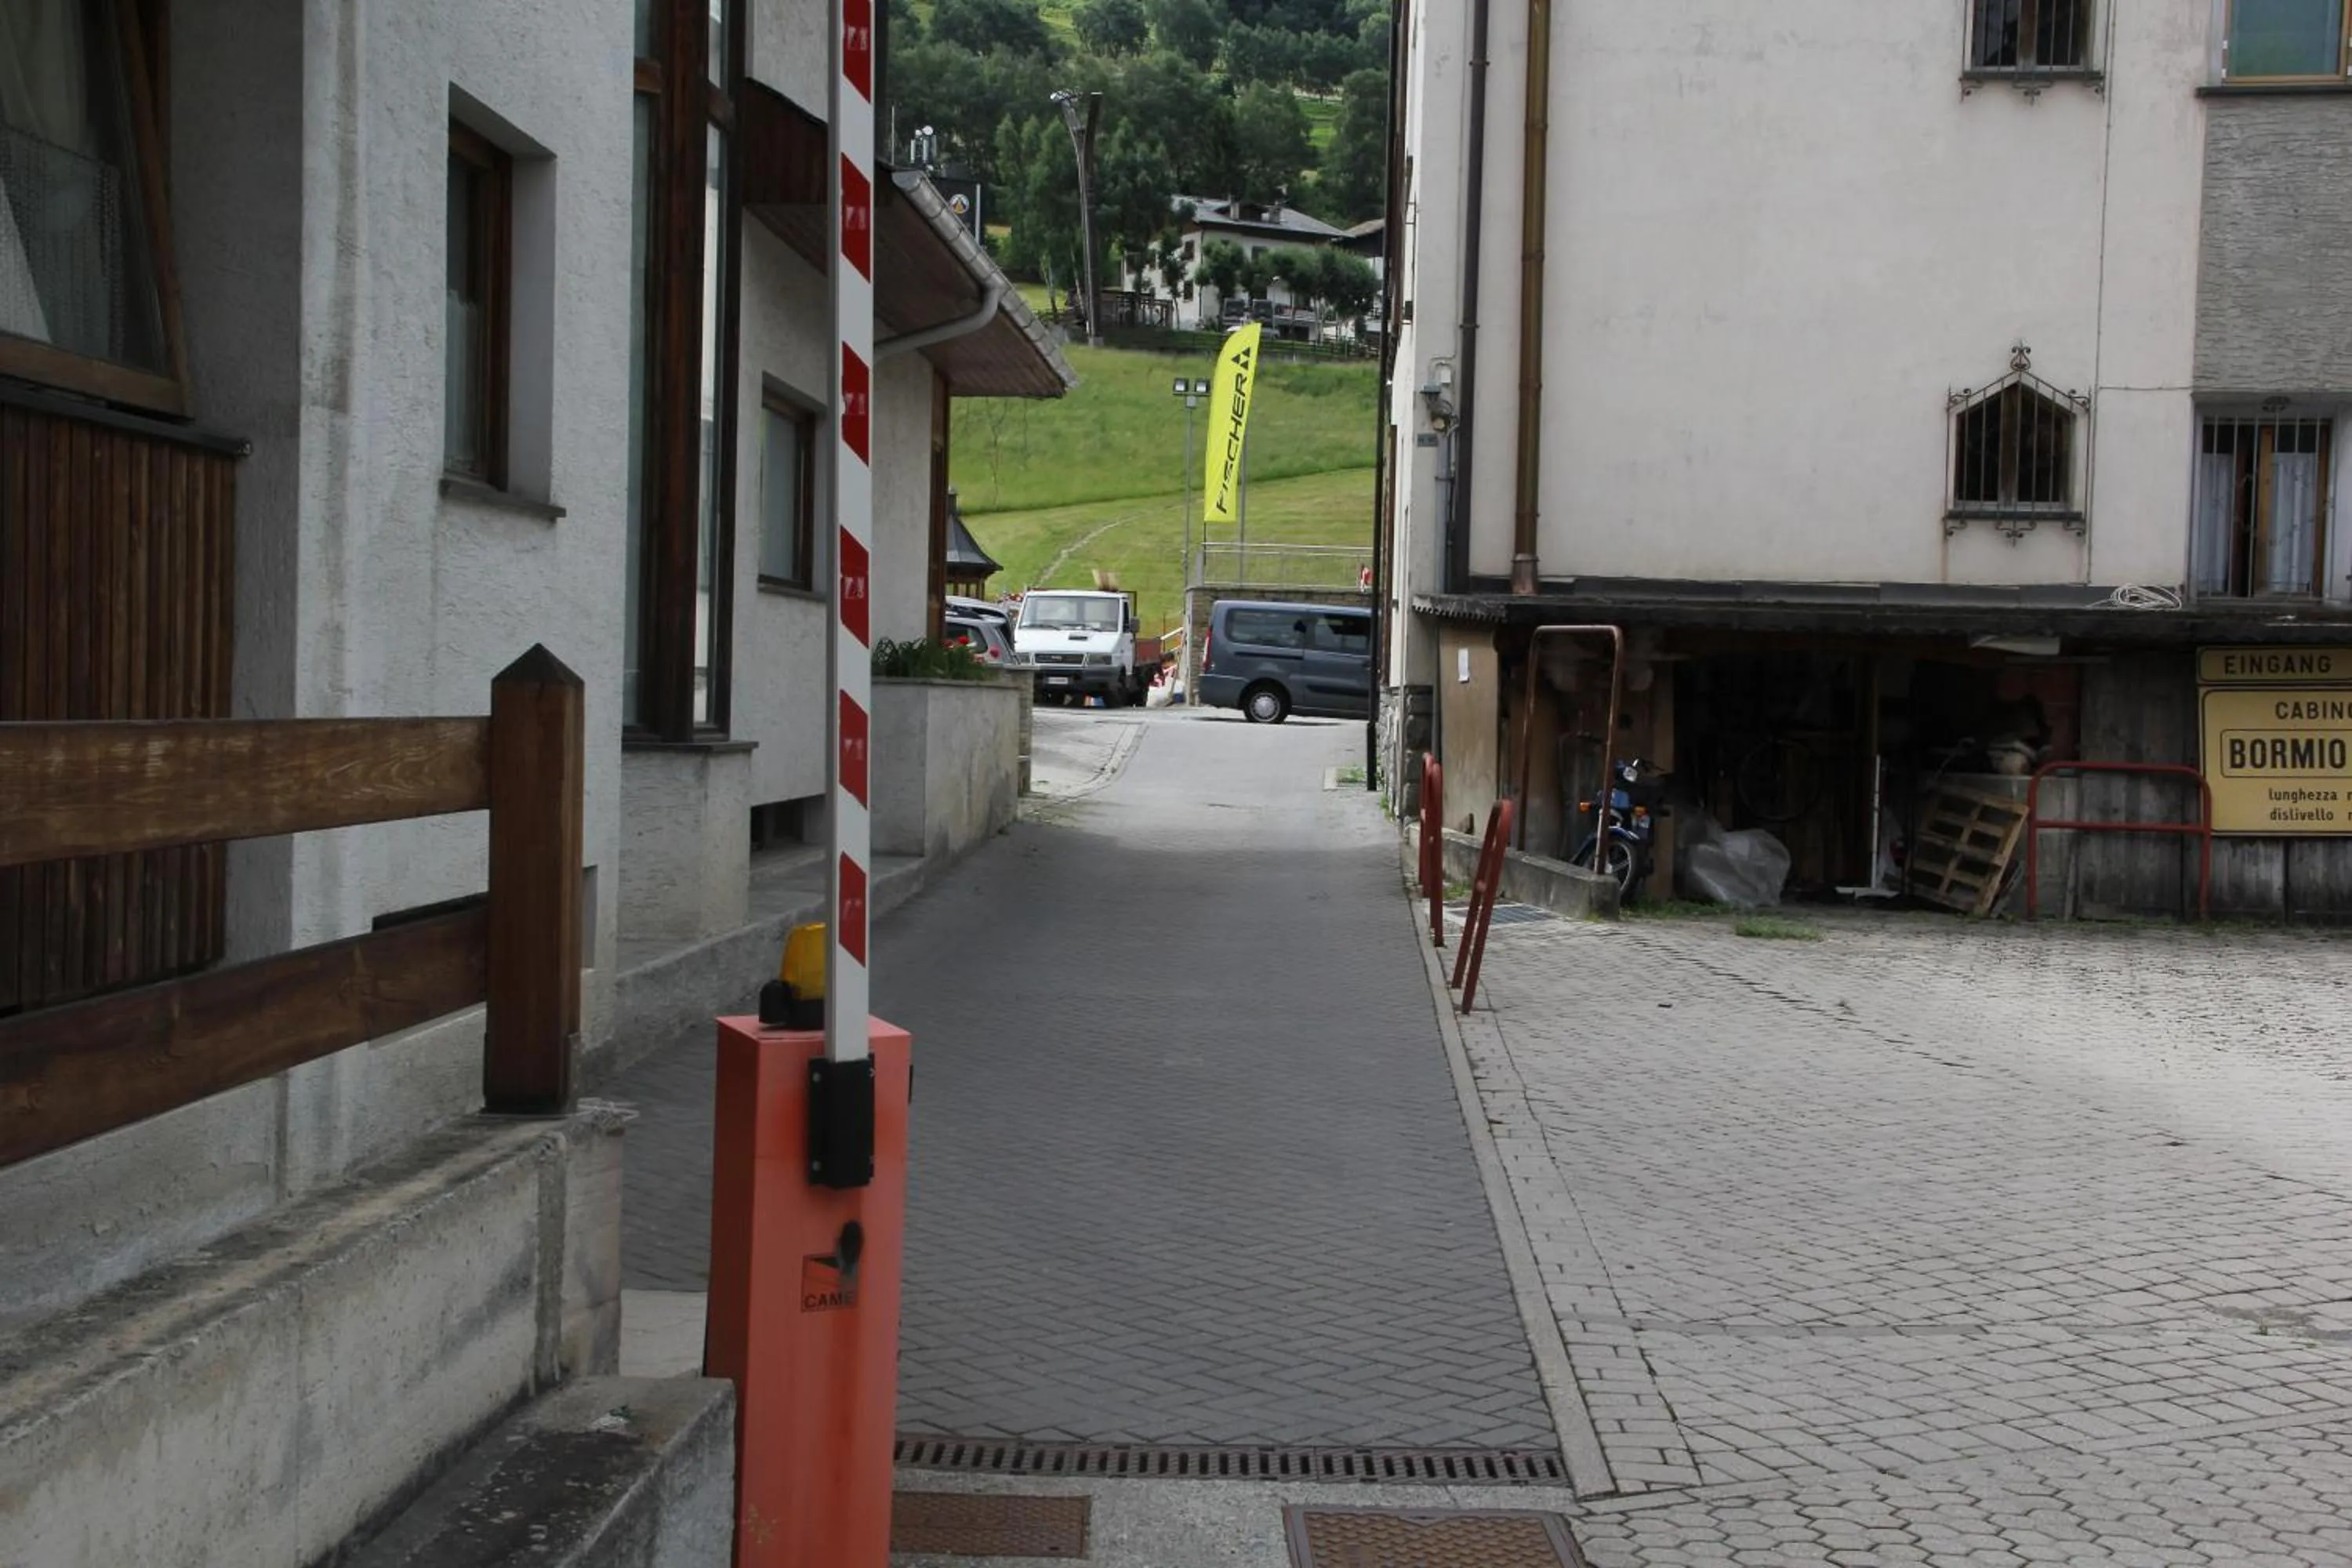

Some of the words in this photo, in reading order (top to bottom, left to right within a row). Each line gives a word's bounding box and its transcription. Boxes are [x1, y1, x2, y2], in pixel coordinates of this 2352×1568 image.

[1216, 372, 1247, 514] FISCHER
[2224, 655, 2332, 674] EINGANG
[2229, 738, 2347, 769] BORMIO
[2269, 788, 2337, 803] lunghezza
[2270, 808, 2334, 821] dislivello
